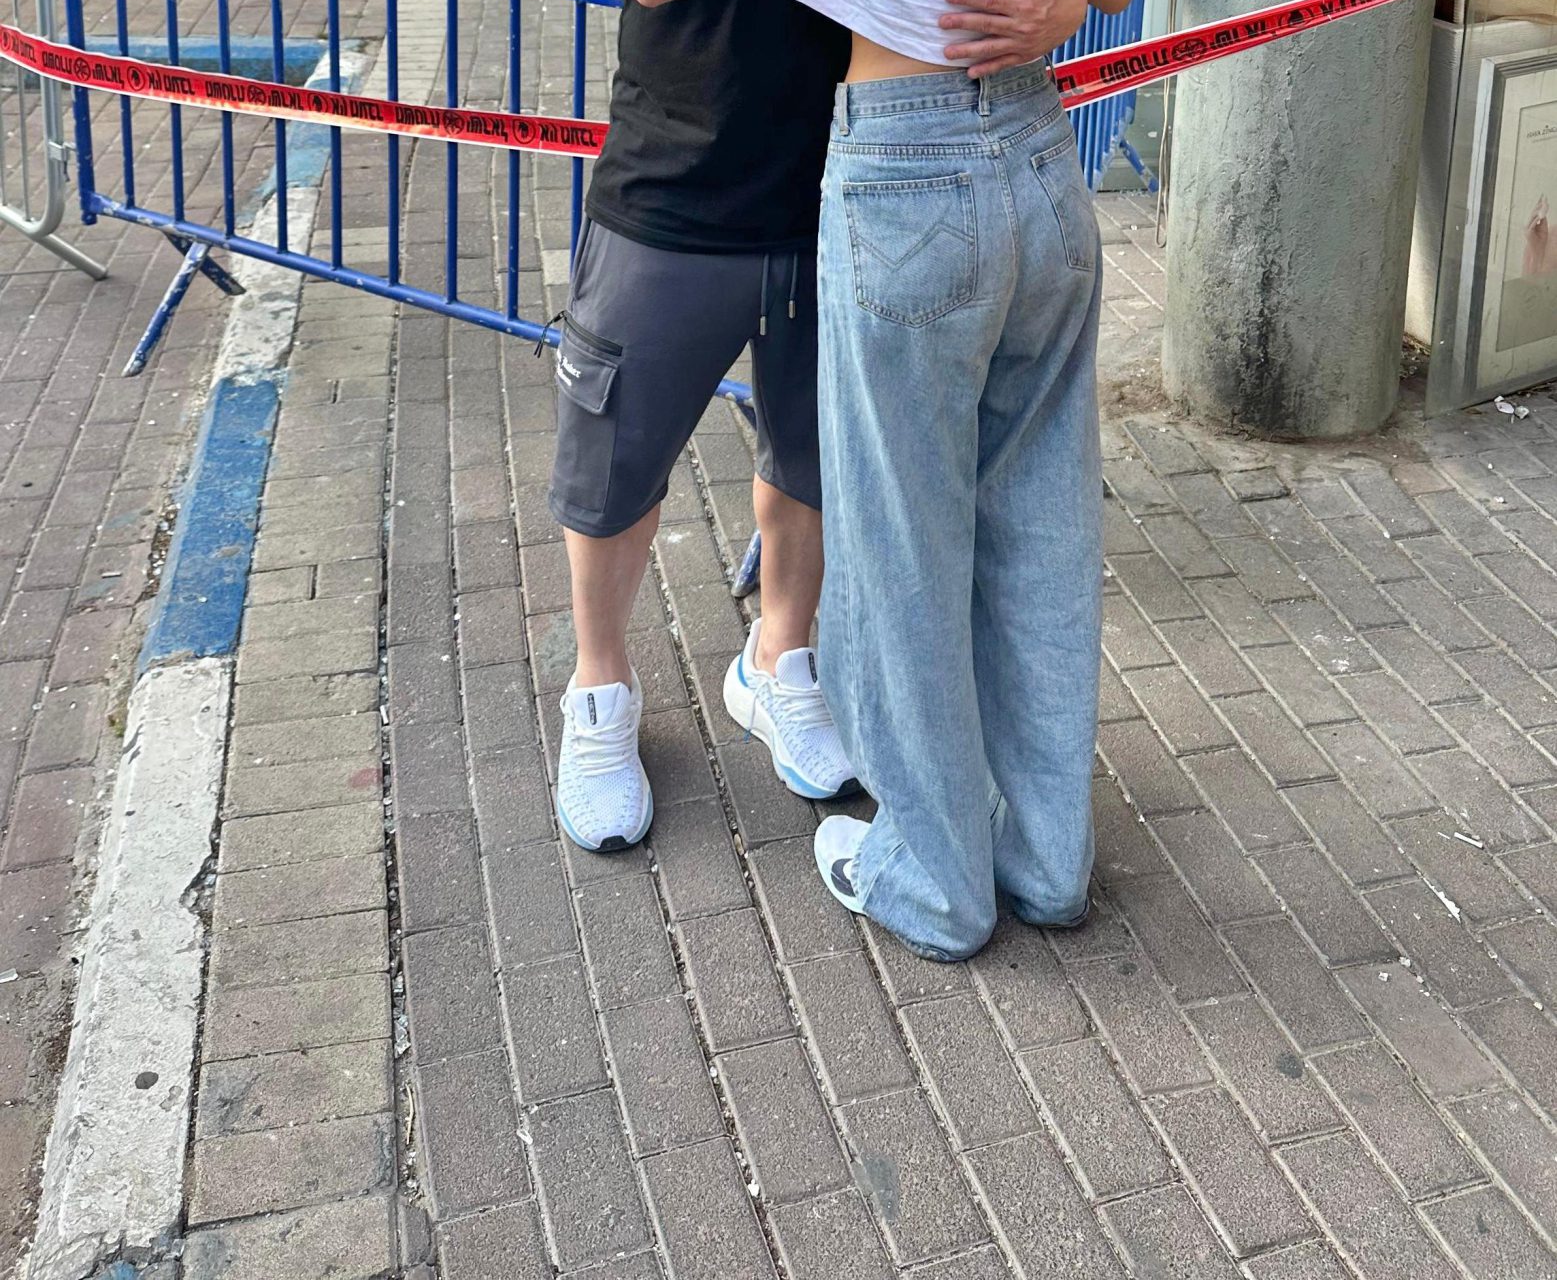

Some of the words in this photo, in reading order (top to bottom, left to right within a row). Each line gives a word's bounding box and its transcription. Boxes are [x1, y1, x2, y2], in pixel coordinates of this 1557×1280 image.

[1100, 47, 1171, 84] משטרת
[42, 51, 73, 75] משטרת
[92, 63, 125, 89] ישראל
[146, 69, 163, 91] אין
[163, 75, 195, 95] מעבר
[205, 80, 246, 103] משטרת
[268, 89, 304, 111] ישראל
[330, 97, 348, 117] אין
[350, 100, 384, 122] מעבר
[395, 105, 440, 129] משטרת
[466, 115, 509, 143] ישראל
[538, 122, 558, 143] אין
[559, 125, 598, 148] מעבר
